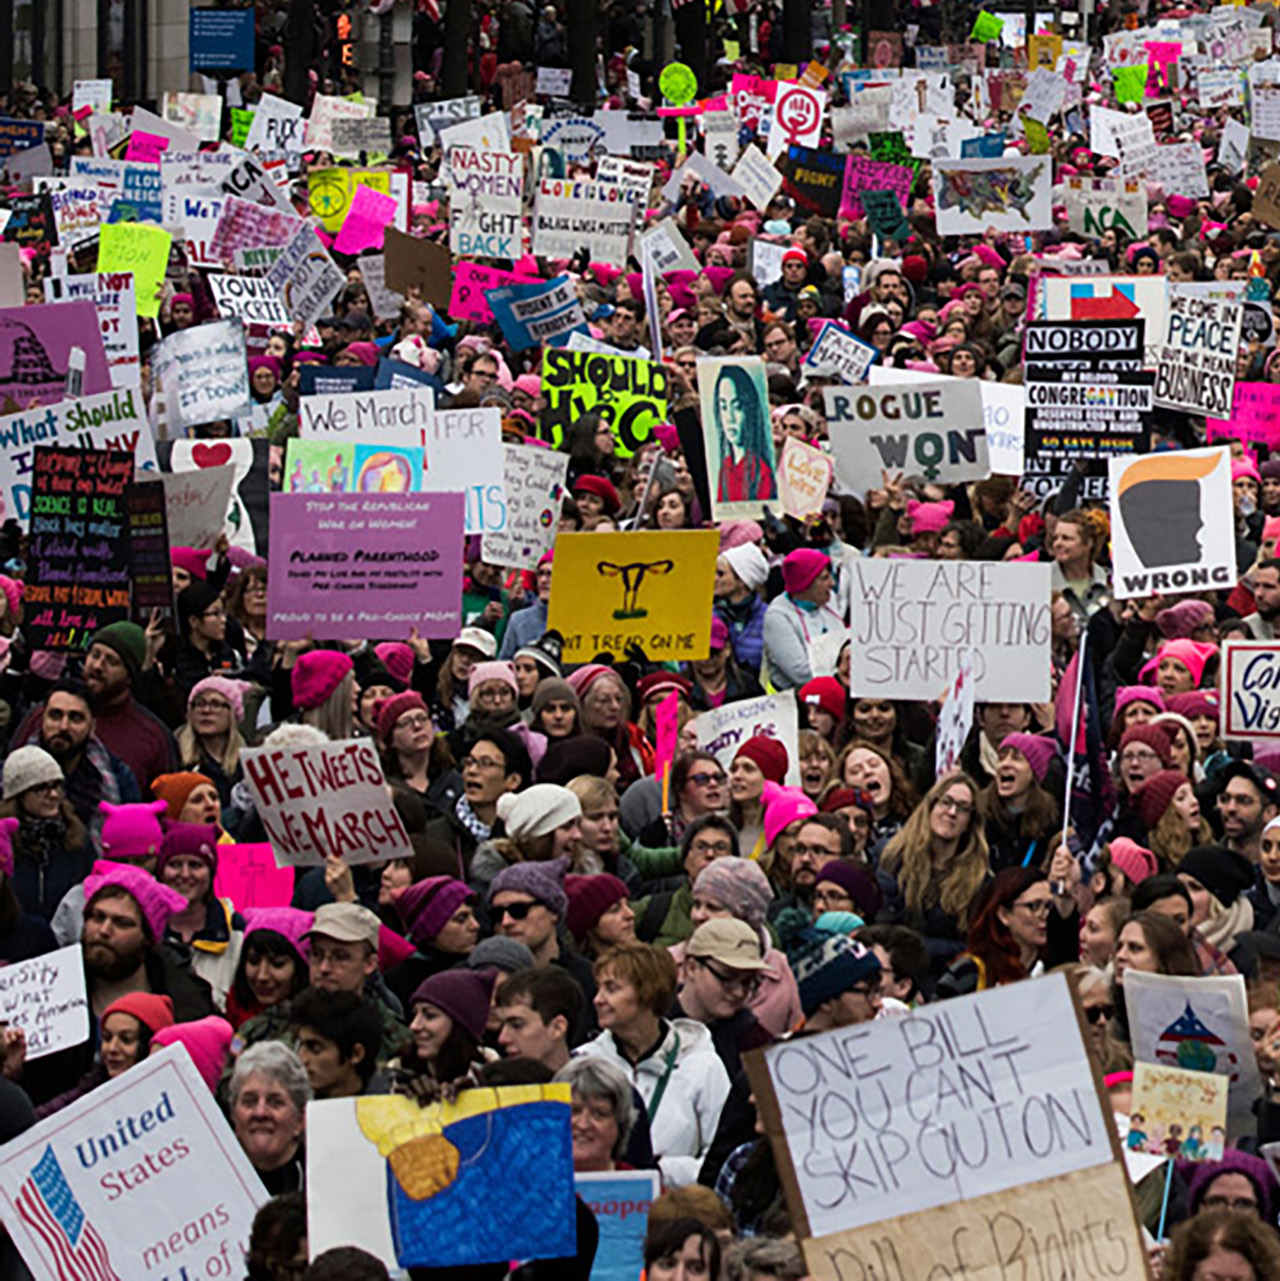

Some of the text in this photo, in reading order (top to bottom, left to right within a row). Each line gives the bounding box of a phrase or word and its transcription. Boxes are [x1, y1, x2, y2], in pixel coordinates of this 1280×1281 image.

[452, 150, 519, 171] NASTY
[452, 175, 521, 198] WOMEN
[458, 234, 511, 256] BACK
[1171, 294, 1237, 322] WE COME IN
[1029, 330, 1135, 351] NOBODY
[1168, 314, 1233, 354] PEACE
[1162, 347, 1234, 375] BUT WE MEAN
[180, 381, 246, 407] IT DOWN
[823, 390, 944, 423] ROGUE
[1029, 386, 1149, 407] CONGREGAYTION
[444, 414, 486, 438] FOR
[869, 426, 987, 480] WON
[1041, 438, 1059, 449] SO
[1063, 438, 1093, 449] SAYS
[1100, 439, 1134, 450] JESUS
[306, 500, 429, 512] STOP THE REPUBLICAN
[290, 550, 440, 562] PLANNED PARENTHOOD
[484, 541, 518, 561] Seeds
[856, 563, 995, 604] WE ARE
[1122, 568, 1230, 593] WRONG
[592, 632, 695, 652] TREAD ON ME
[247, 744, 384, 806] HE TWEETS
[772, 1006, 1018, 1097] ONE BILL
[74, 1092, 177, 1170] United
[804, 1088, 1093, 1209] SKIP OUT ON
[100, 1138, 191, 1201] States
[142, 1204, 230, 1270] means
